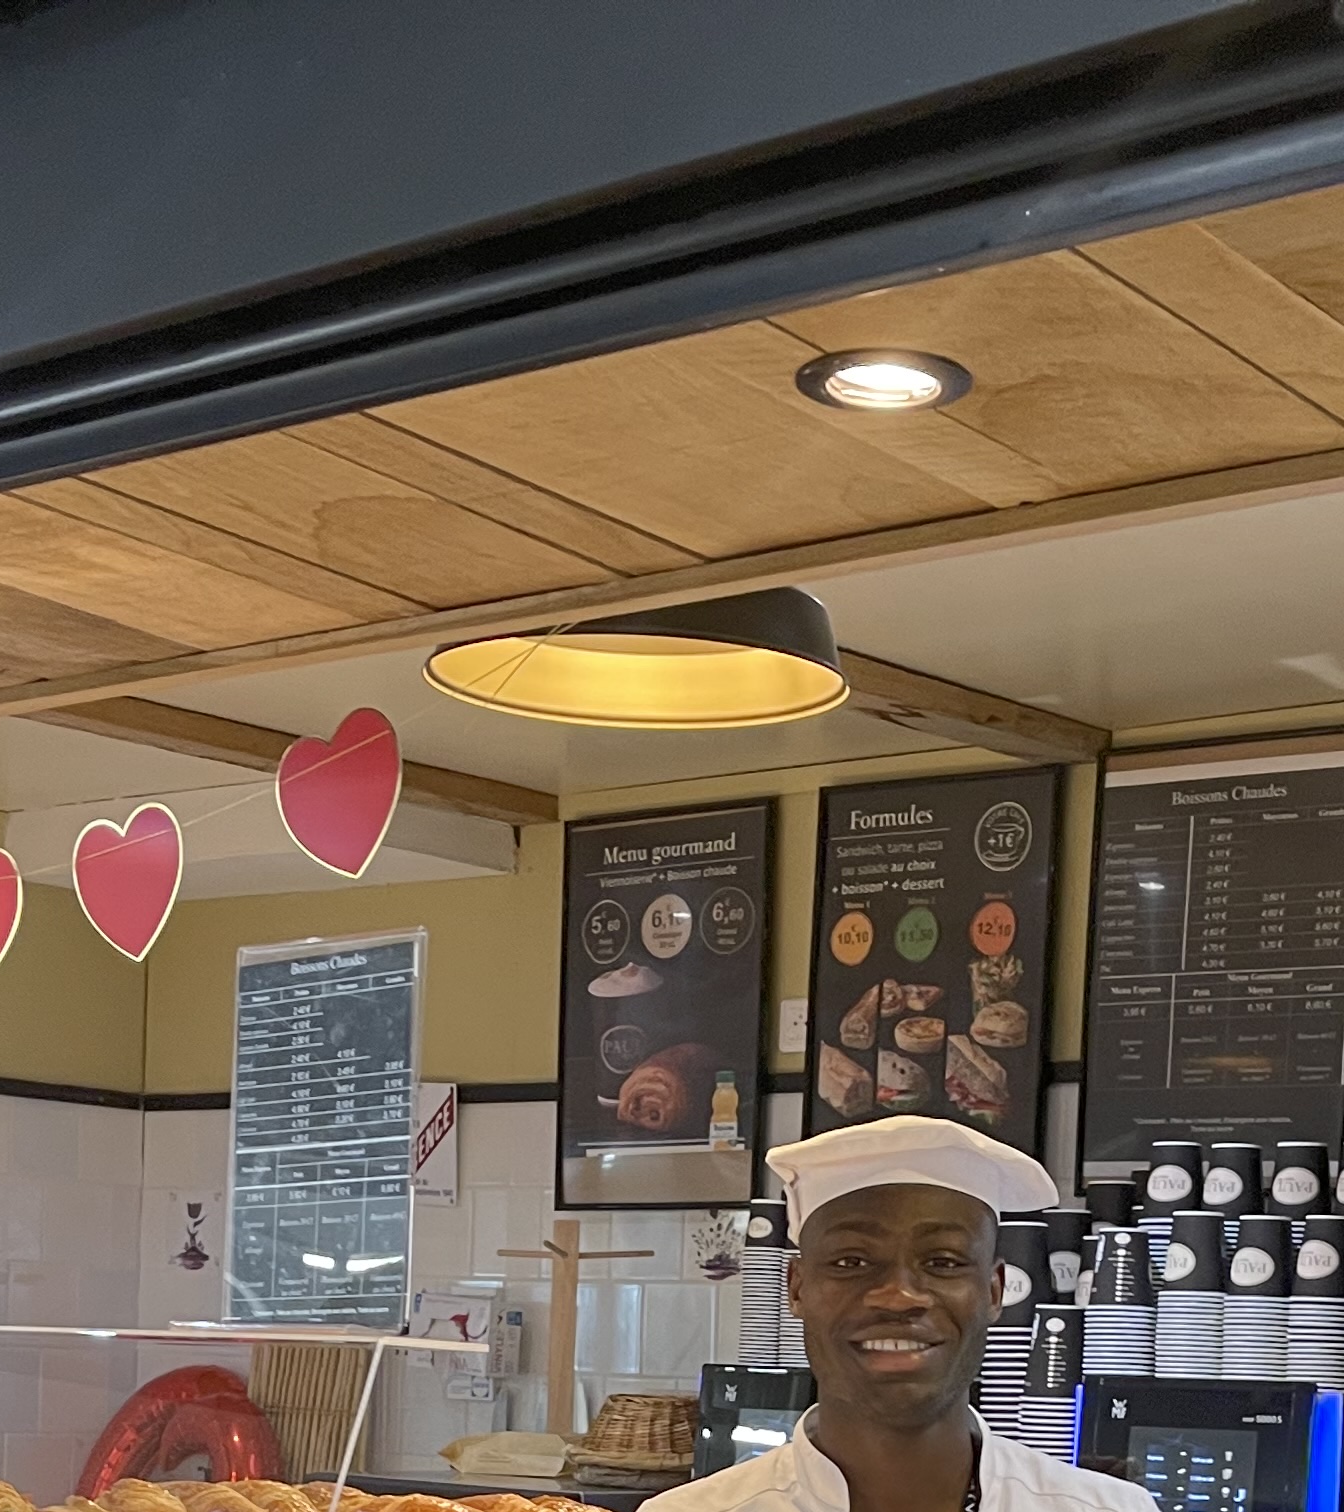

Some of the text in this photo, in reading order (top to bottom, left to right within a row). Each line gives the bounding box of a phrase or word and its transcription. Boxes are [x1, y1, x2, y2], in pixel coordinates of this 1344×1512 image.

[1172, 784, 1287, 805] Boissons Chaudes
[850, 804, 933, 830] Formules
[603, 832, 736, 865] Menu gourmand
[890, 863, 904, 872] au
[907, 860, 936, 871] choix
[902, 878, 944, 891] dessert
